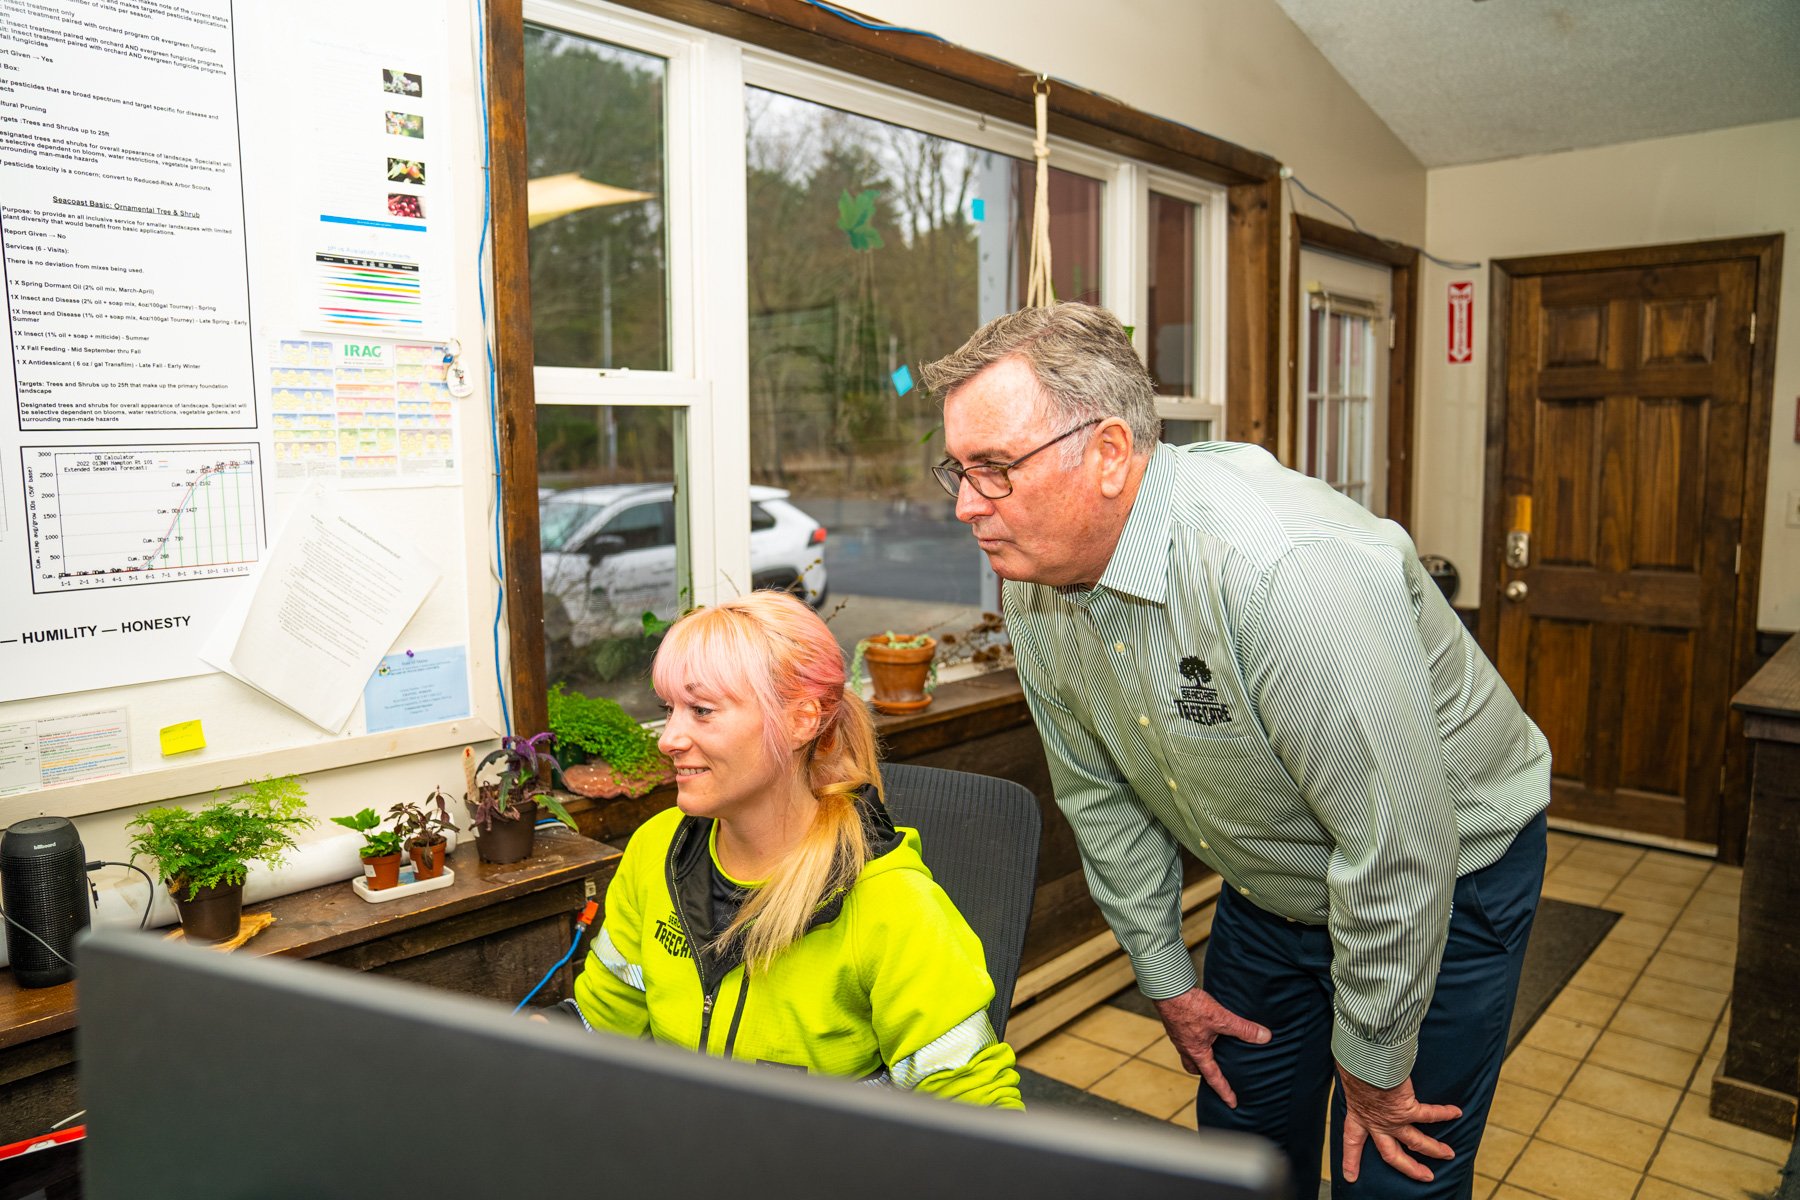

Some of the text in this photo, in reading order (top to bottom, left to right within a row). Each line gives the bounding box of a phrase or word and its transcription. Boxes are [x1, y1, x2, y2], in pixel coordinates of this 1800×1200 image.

[12, 35, 48, 47] fungicides
[10, 49, 30, 58] Given
[3, 63, 20, 71] Box:
[10, 80, 44, 90] pesticides
[72, 90, 91, 98] broad
[19, 103, 46, 113] Pruning
[56, 123, 79, 132] Shrubs
[38, 151, 98, 163] man-made hazards
[3, 160, 34, 168] pesticide
[35, 164, 59, 173] toxicity
[52, 196, 88, 206] Seacoast
[89, 200, 112, 209] Basic:
[3, 227, 26, 235] Report
[5, 242, 33, 250] Services
[21, 280, 42, 288] Spring
[344, 344, 382, 358] IRAC
[22, 625, 97, 644] HUMILITY
[121, 616, 191, 633] HONESTY
